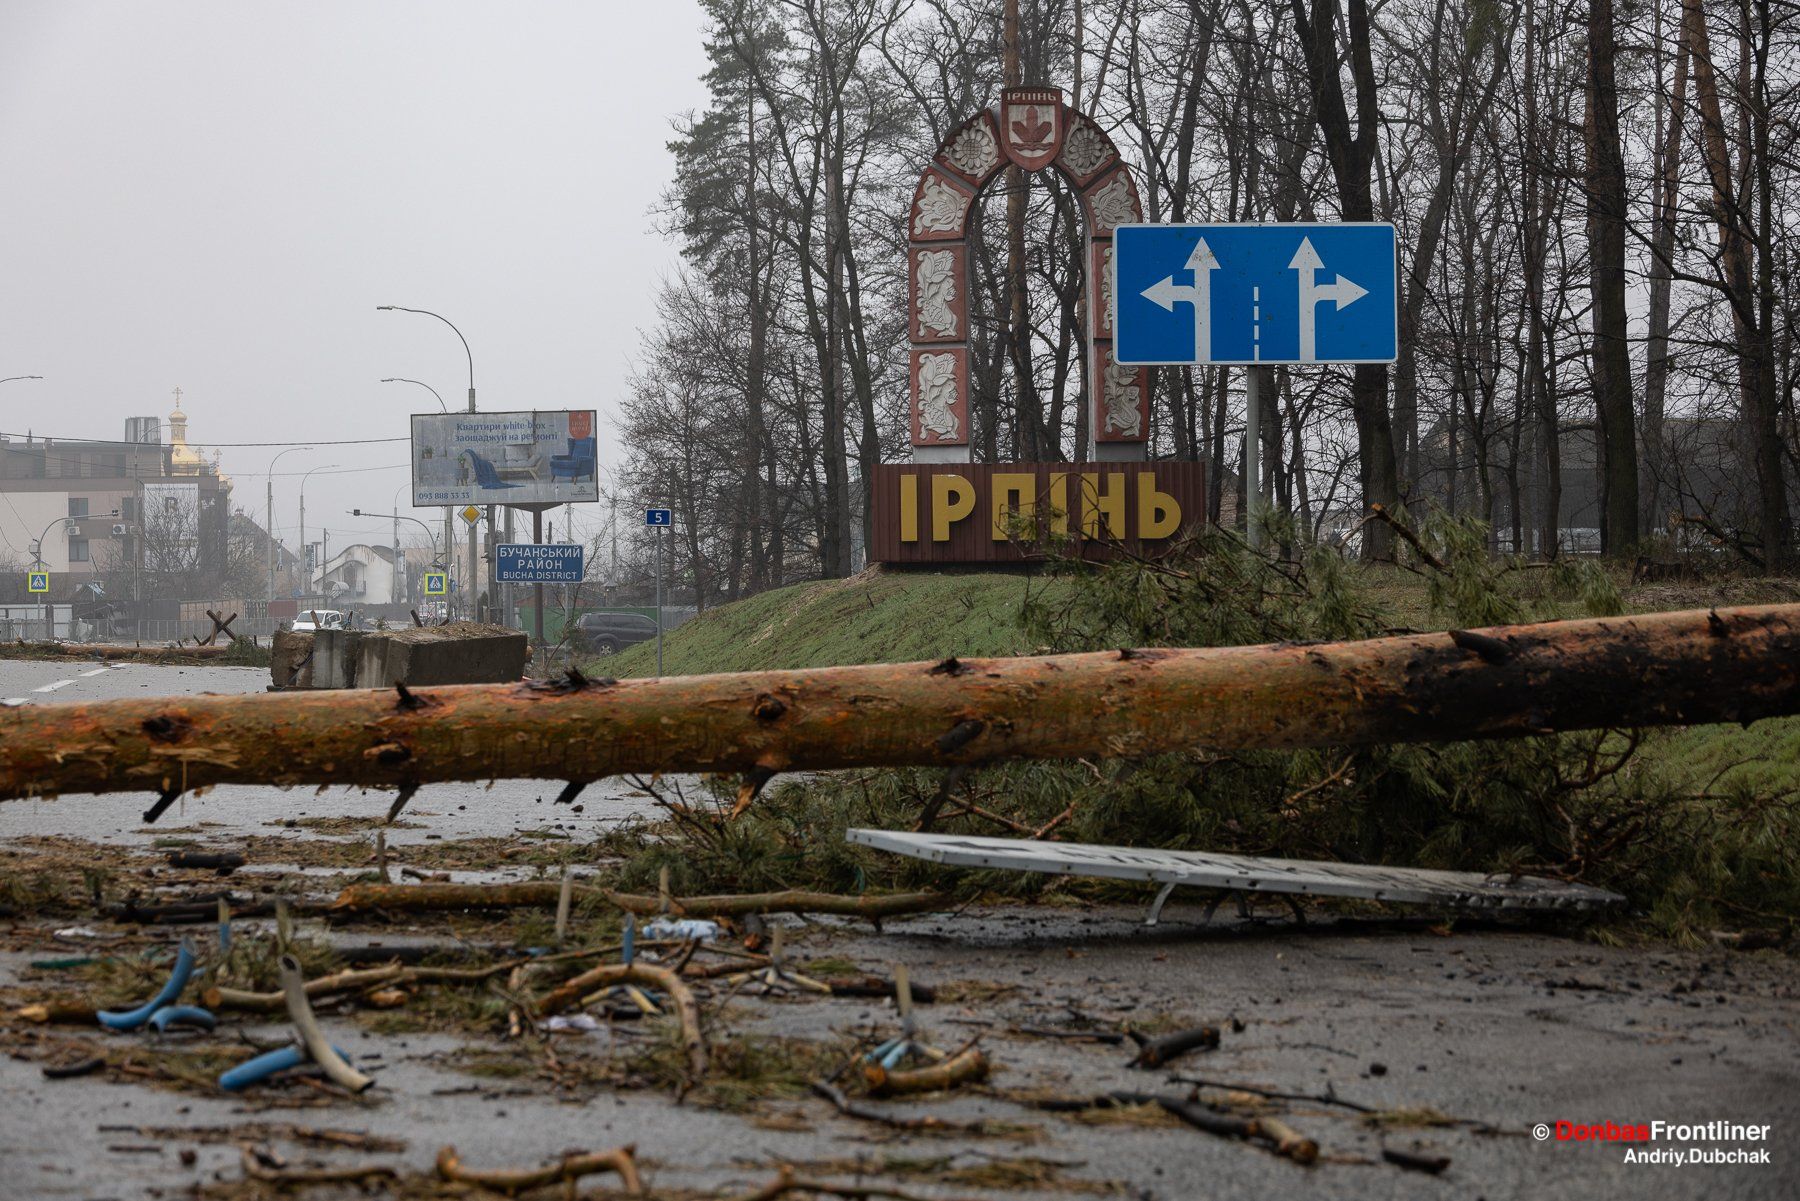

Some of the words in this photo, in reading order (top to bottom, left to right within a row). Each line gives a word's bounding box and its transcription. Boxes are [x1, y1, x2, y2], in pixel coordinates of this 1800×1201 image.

[1007, 92, 1056, 101] ІРПІНЬ
[456, 422, 500, 432] Квартири
[455, 432, 507, 443] заощаджуй
[418, 492, 433, 500] 093
[900, 471, 1182, 542] ІРПІНЬ
[655, 512, 662, 523] 5
[500, 546, 580, 558] БУЧАНСЬКИЙ
[518, 558, 562, 570] РАЙОН
[503, 571, 534, 579] BUCHA
[536, 571, 577, 580] DISTRICT
